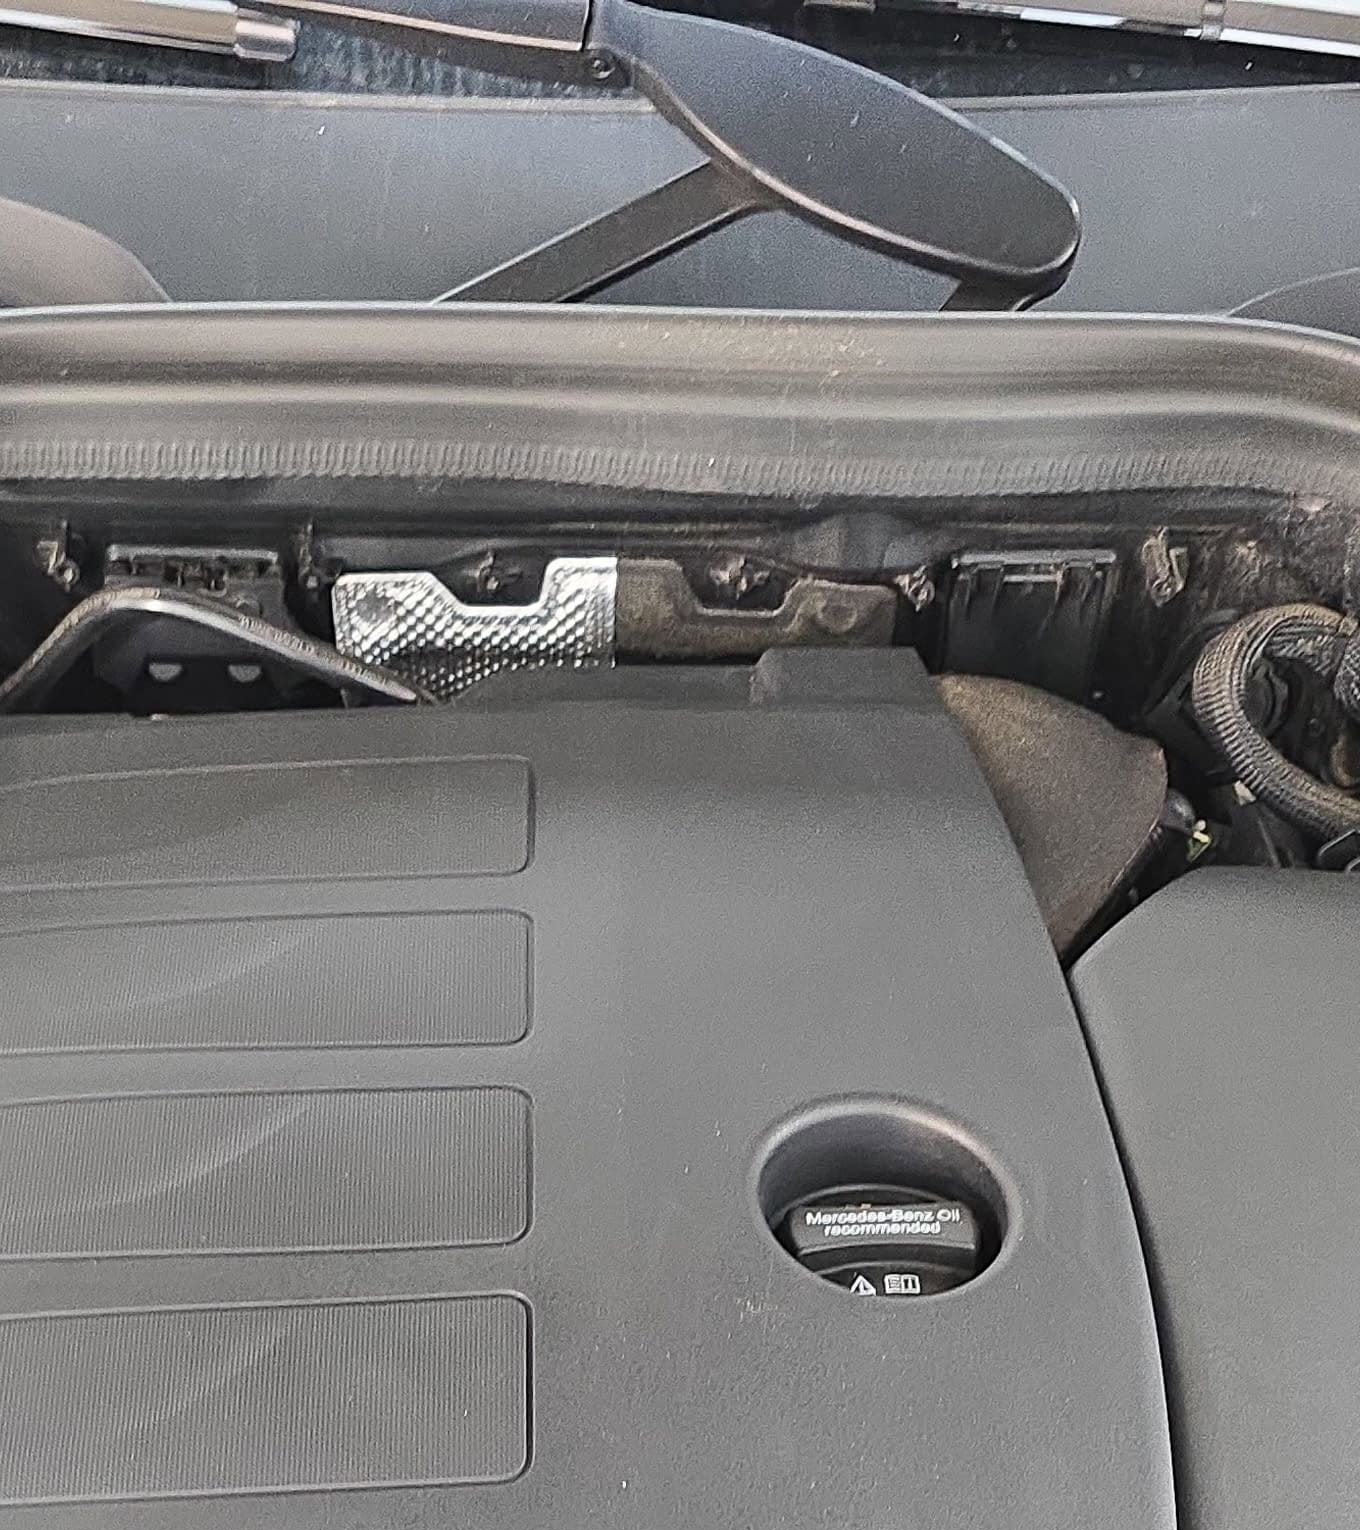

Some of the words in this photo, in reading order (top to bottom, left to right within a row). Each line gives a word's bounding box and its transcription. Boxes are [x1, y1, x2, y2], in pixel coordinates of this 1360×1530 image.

[805, 1208, 934, 1226] Mercedes-Benz
[936, 1207, 960, 1223] Oil
[823, 1221, 941, 1237] recommended
